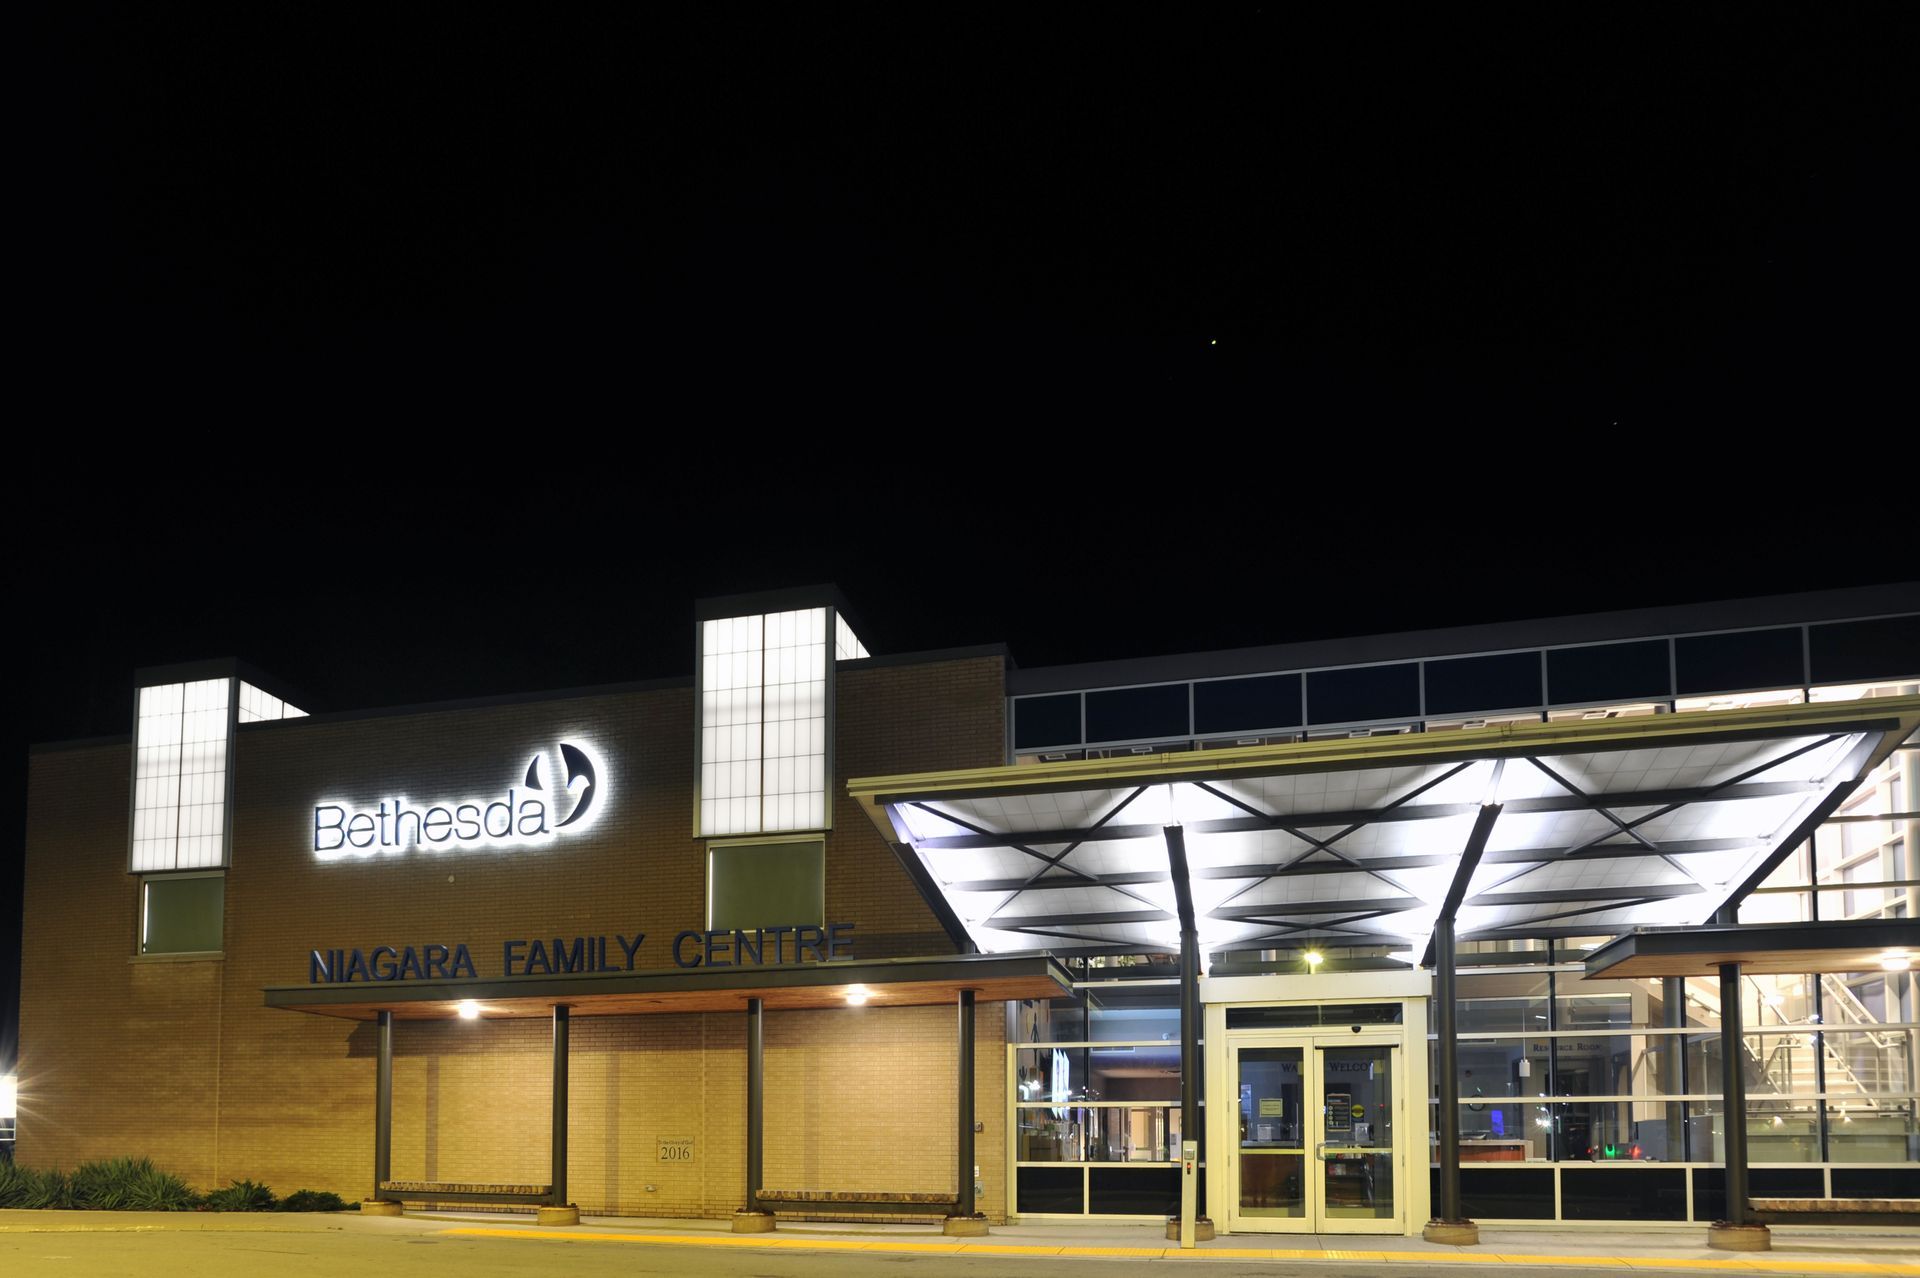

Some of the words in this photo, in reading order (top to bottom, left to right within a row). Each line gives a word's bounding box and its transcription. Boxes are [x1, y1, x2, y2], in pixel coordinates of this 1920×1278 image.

[314, 789, 550, 852] Bethesda
[309, 944, 478, 984] NIAGARA
[503, 933, 645, 977] FAMILY
[672, 923, 855, 969] CENTRE
[1533, 1043, 1573, 1052] RESRCE
[1329, 1062, 1370, 1072] WELCO
[661, 1146, 690, 1160] 2016
